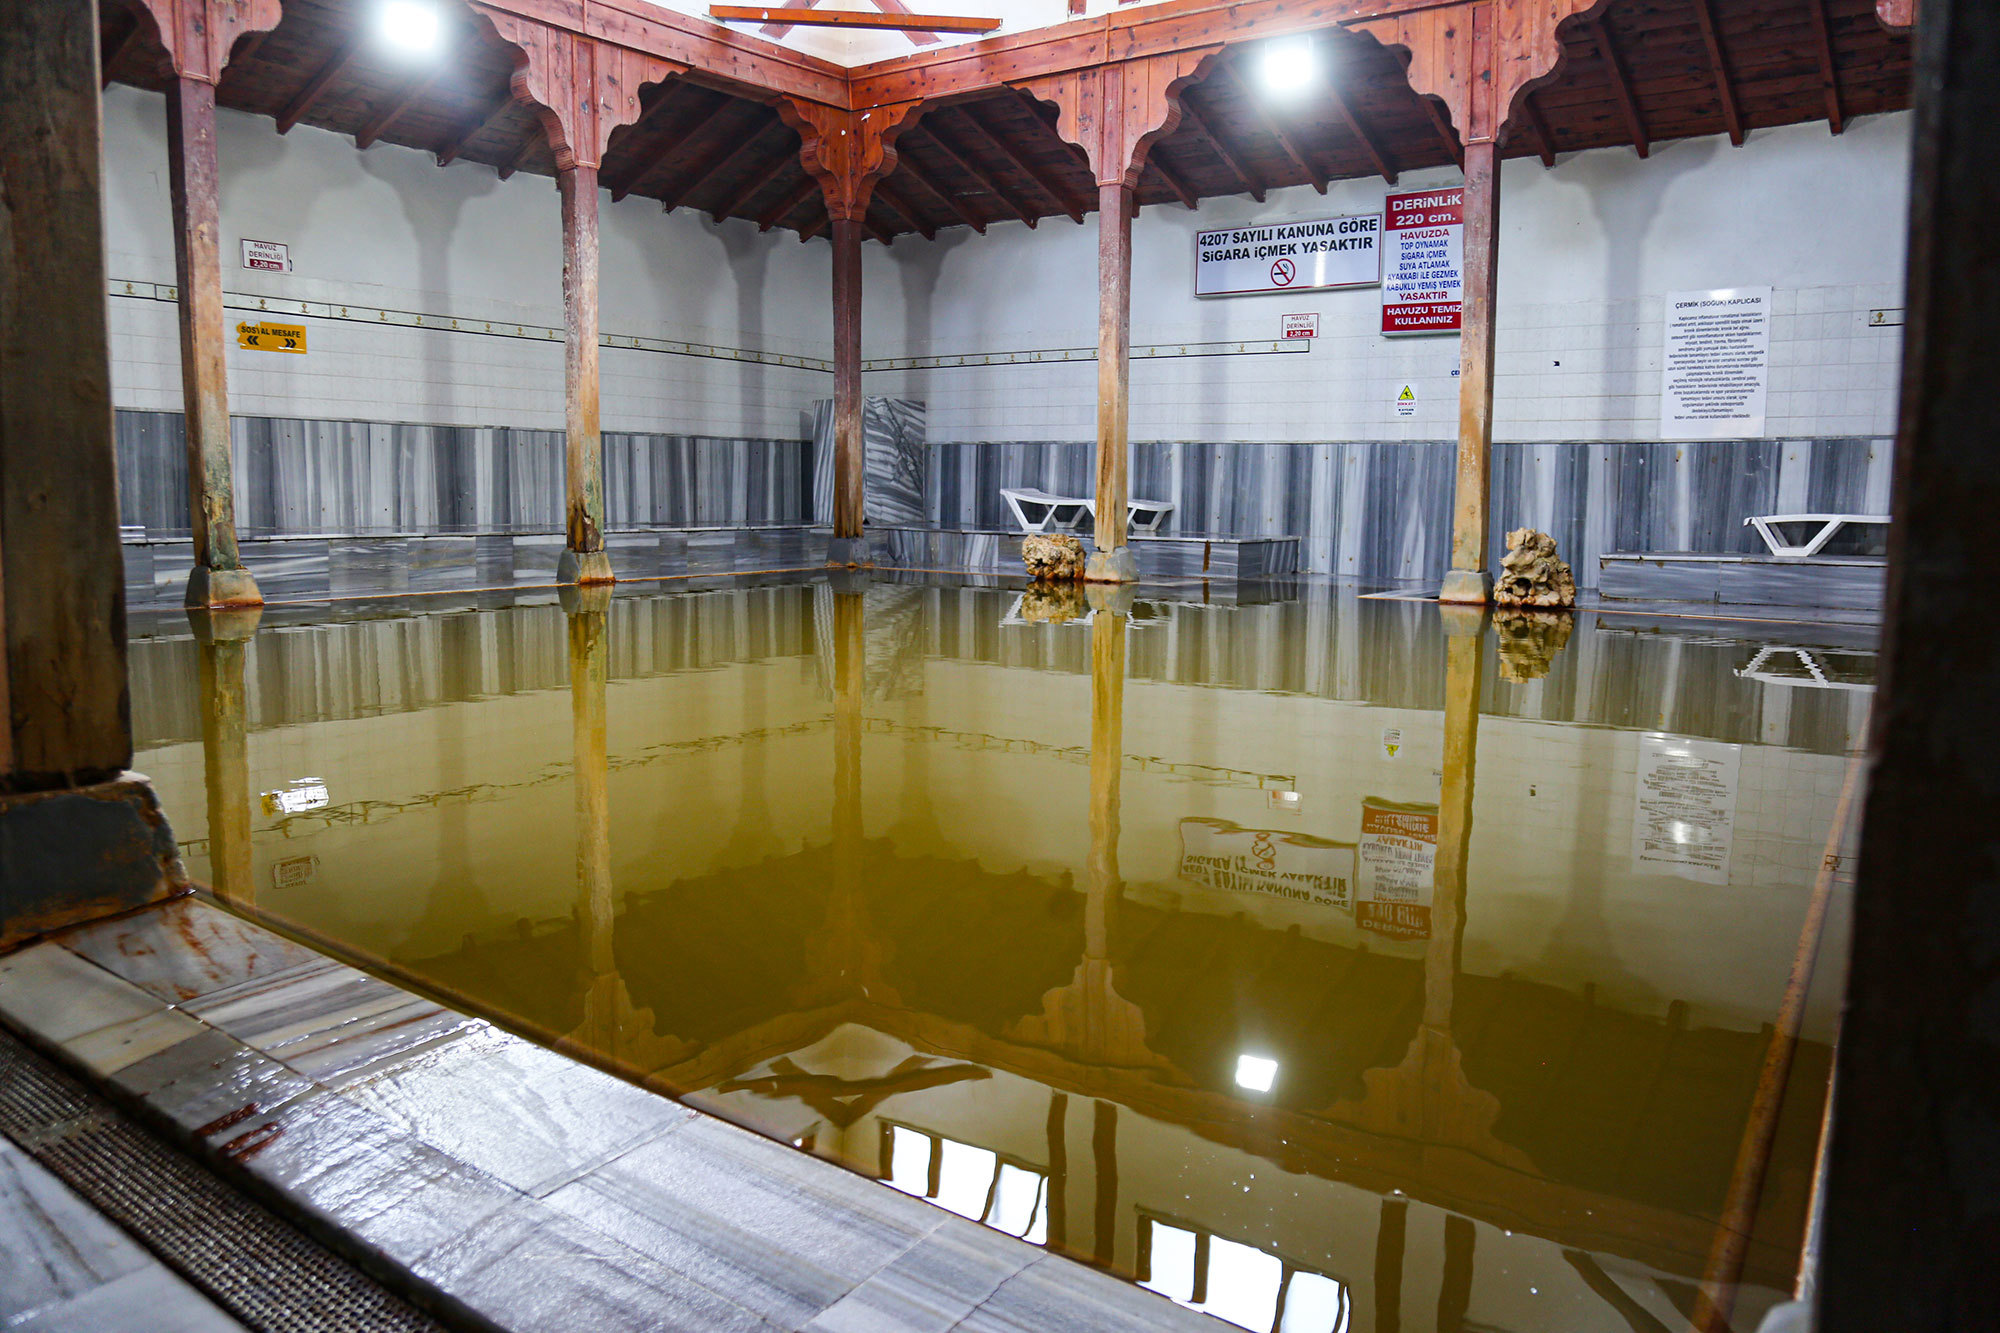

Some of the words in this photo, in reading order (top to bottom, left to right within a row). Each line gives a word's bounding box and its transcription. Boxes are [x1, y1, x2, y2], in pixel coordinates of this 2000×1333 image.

[1396, 213, 1424, 226] 220
[1428, 213, 1456, 223] cm.
[1200, 233, 1229, 246] 4207
[1232, 228, 1273, 243] SAYILI
[1277, 222, 1334, 240] KANUNA
[1338, 217, 1378, 233] GÖRE
[1400, 229, 1450, 240] HAVUZDA
[254, 242, 276, 251] HAVUZ
[1302, 237, 1373, 253] YASAKTIR
[1400, 242, 1413, 250] TOP
[1414, 239, 1448, 249] OYNAMAK
[1399, 262, 1416, 271] SUYA
[1418, 260, 1450, 269] ATLAMAK
[1387, 272, 1418, 280] AYAKKABI
[1431, 270, 1459, 279] GEZMEK
[1386, 282, 1416, 291] KABUKLU
[1439, 280, 1461, 288] YEMEK
[1400, 291, 1448, 301] YASAKTIR
[1387, 306, 1429, 316] HAVUZU
[1395, 316, 1453, 325] KULLANINIZ
[272, 328, 301, 338] MESAFE
